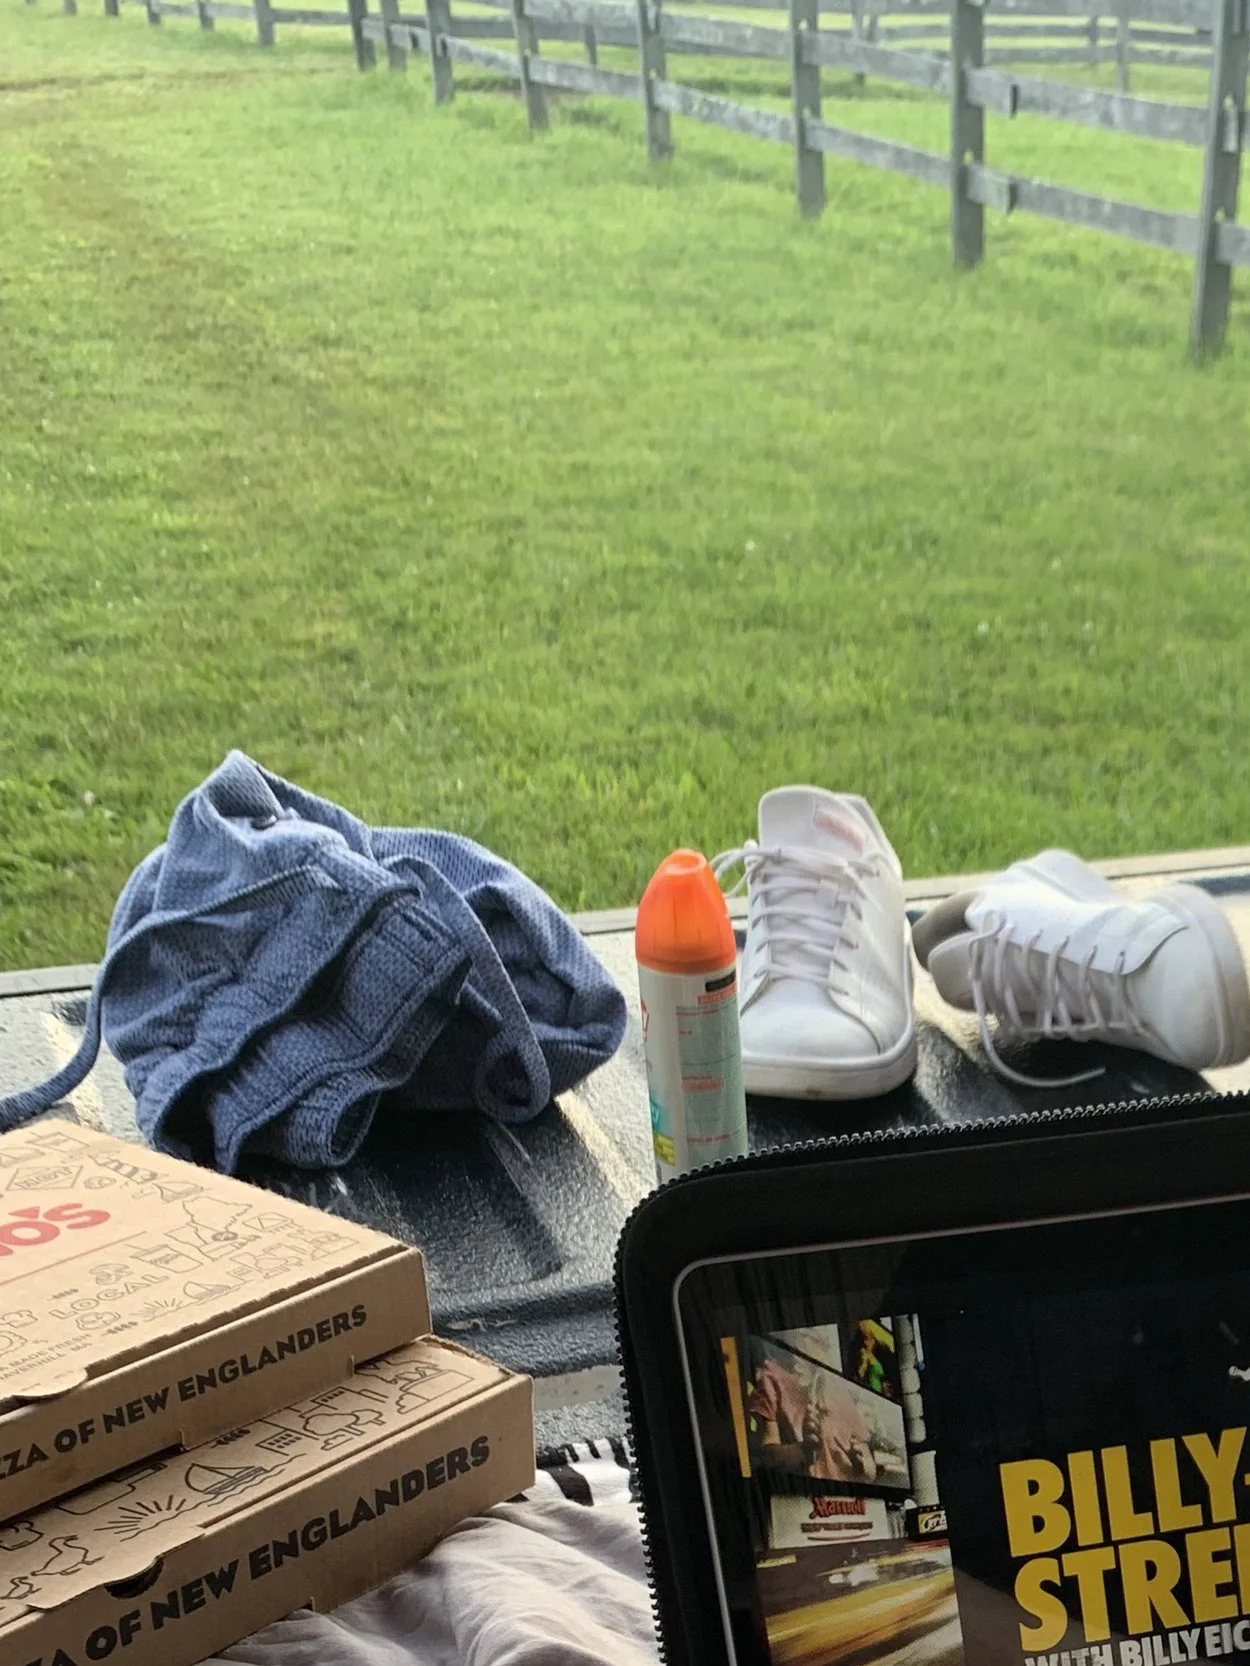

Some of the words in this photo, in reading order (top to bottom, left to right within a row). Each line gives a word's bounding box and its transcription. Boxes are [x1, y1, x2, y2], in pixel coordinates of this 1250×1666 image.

[0, 1202, 111, 1257] O'S
[48, 1274, 169, 1320] LOCAL
[0, 1443, 49, 1480] ZA
[54, 1418, 96, 1453] OF
[103, 1387, 174, 1434] NEW
[178, 1304, 368, 1403] ENGLANDERS
[9, 1349, 48, 1368] MADE
[48, 1333, 93, 1352] FRESH
[999, 1427, 1247, 1557] BILLY
[85, 1609, 141, 1661] OF
[151, 1559, 241, 1631] NEW
[248, 1434, 491, 1579] ENGLANDERS
